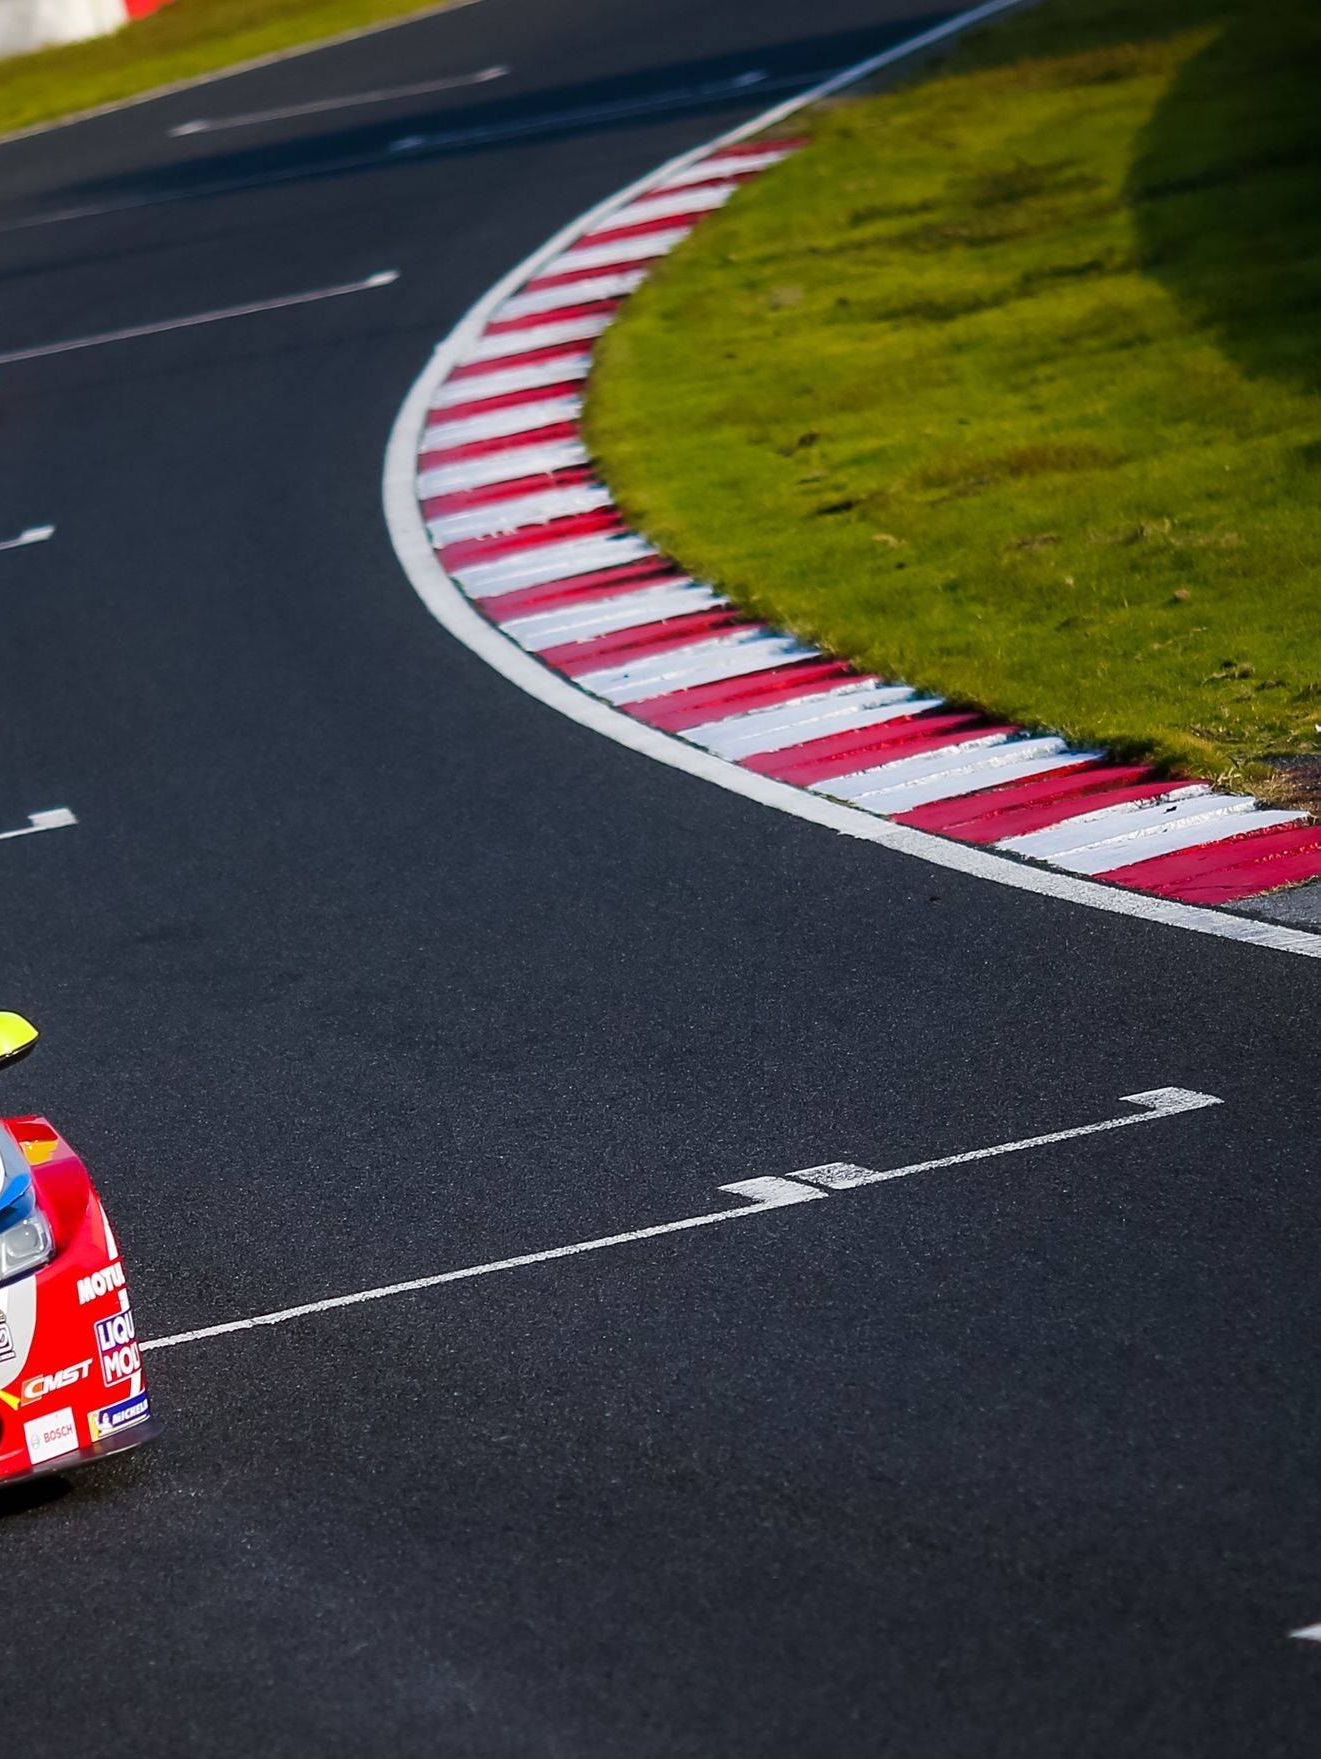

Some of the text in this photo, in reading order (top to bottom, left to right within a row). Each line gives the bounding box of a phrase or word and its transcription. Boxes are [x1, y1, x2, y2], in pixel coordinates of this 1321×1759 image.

[97, 1311, 135, 1351] LIQU
[24, 1358, 93, 1398] CMST
[103, 1342, 141, 1382] MOL
[43, 1424, 74, 1444] BOSCH
